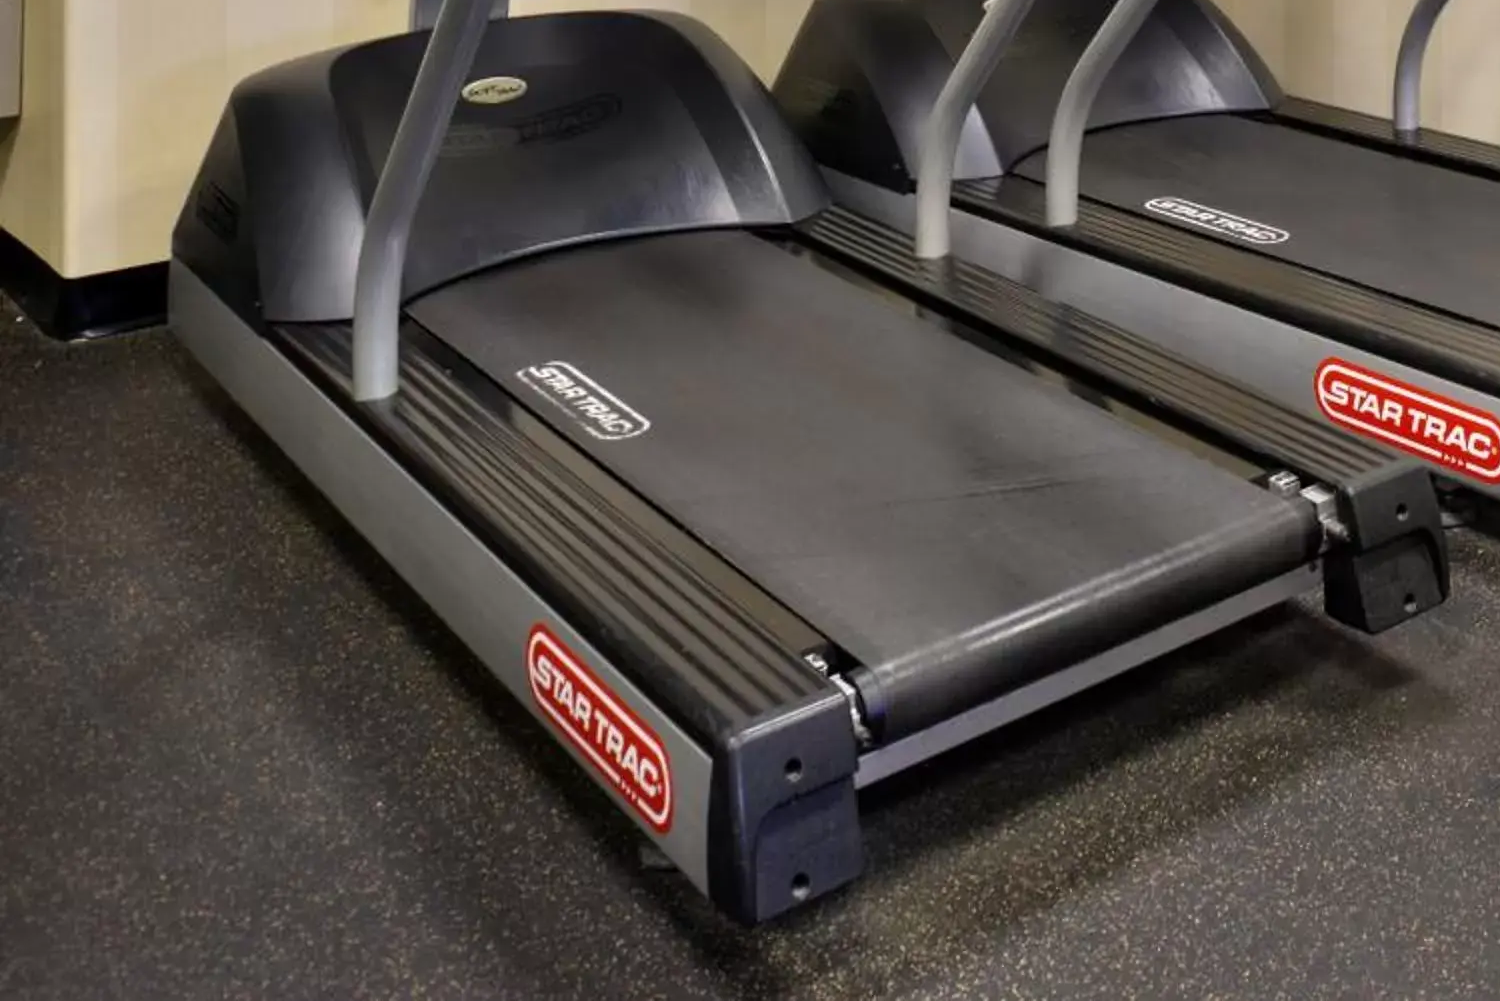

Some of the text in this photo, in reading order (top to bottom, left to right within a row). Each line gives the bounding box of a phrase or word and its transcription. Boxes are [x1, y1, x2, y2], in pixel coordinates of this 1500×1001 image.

[1158, 201, 1278, 241] STAR TRAC
[529, 366, 633, 433] STAR TRAC
[1326, 380, 1493, 460] STAR TRAC
[534, 655, 660, 797] STAR TRAC
